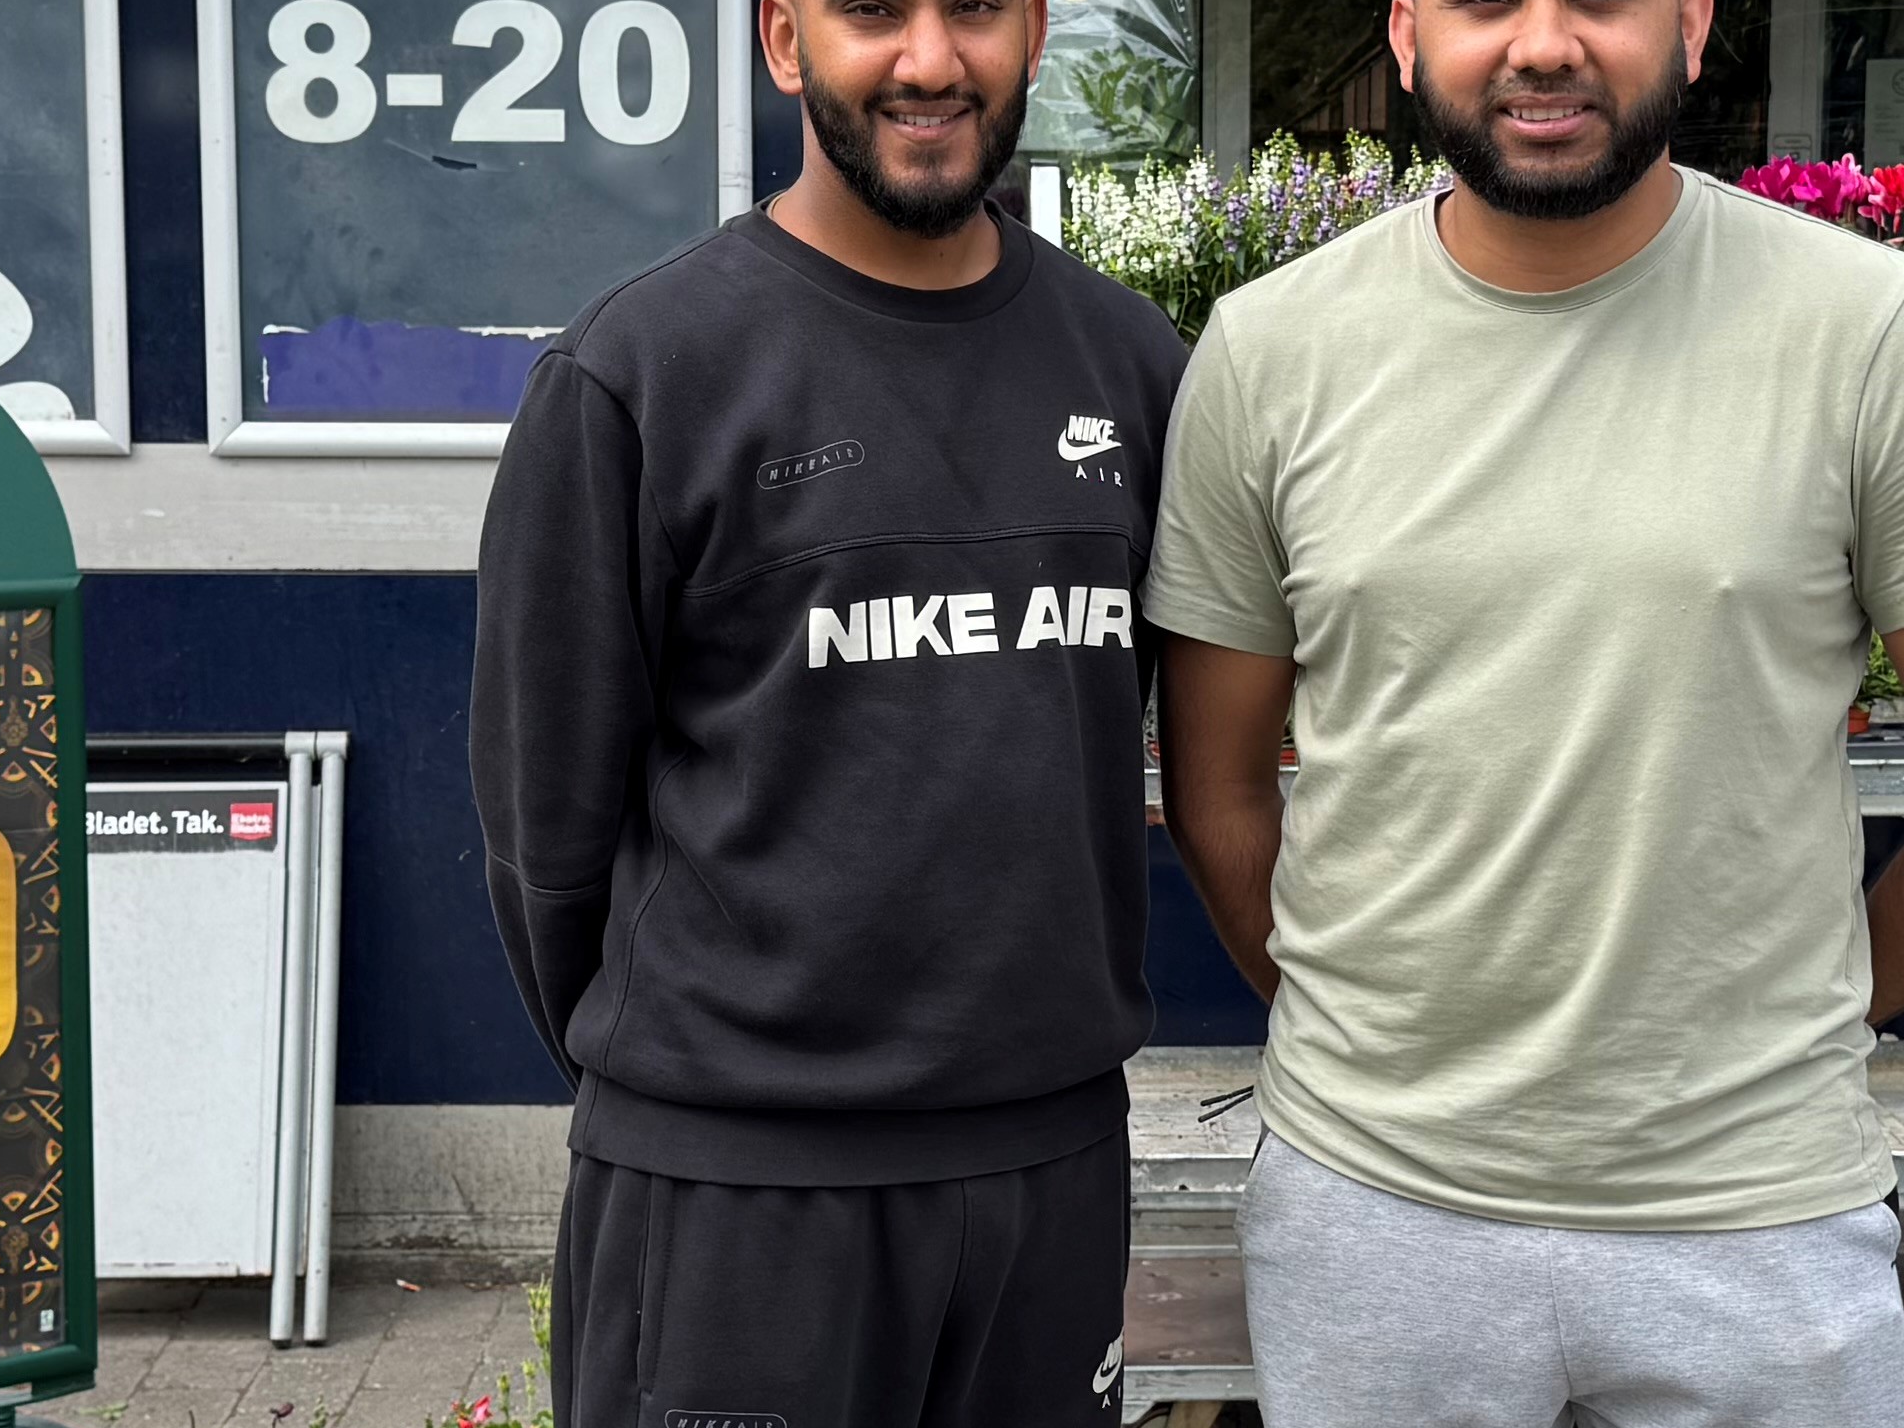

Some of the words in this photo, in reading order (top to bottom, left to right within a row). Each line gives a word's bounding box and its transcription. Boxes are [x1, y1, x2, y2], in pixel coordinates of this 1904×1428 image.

[1066, 415, 1115, 444] NIKE
[1075, 464, 1123, 487] AIR
[808, 592, 1000, 669] NIKE
[1016, 586, 1134, 651] AIR
[172, 809, 224, 834] Tak.
